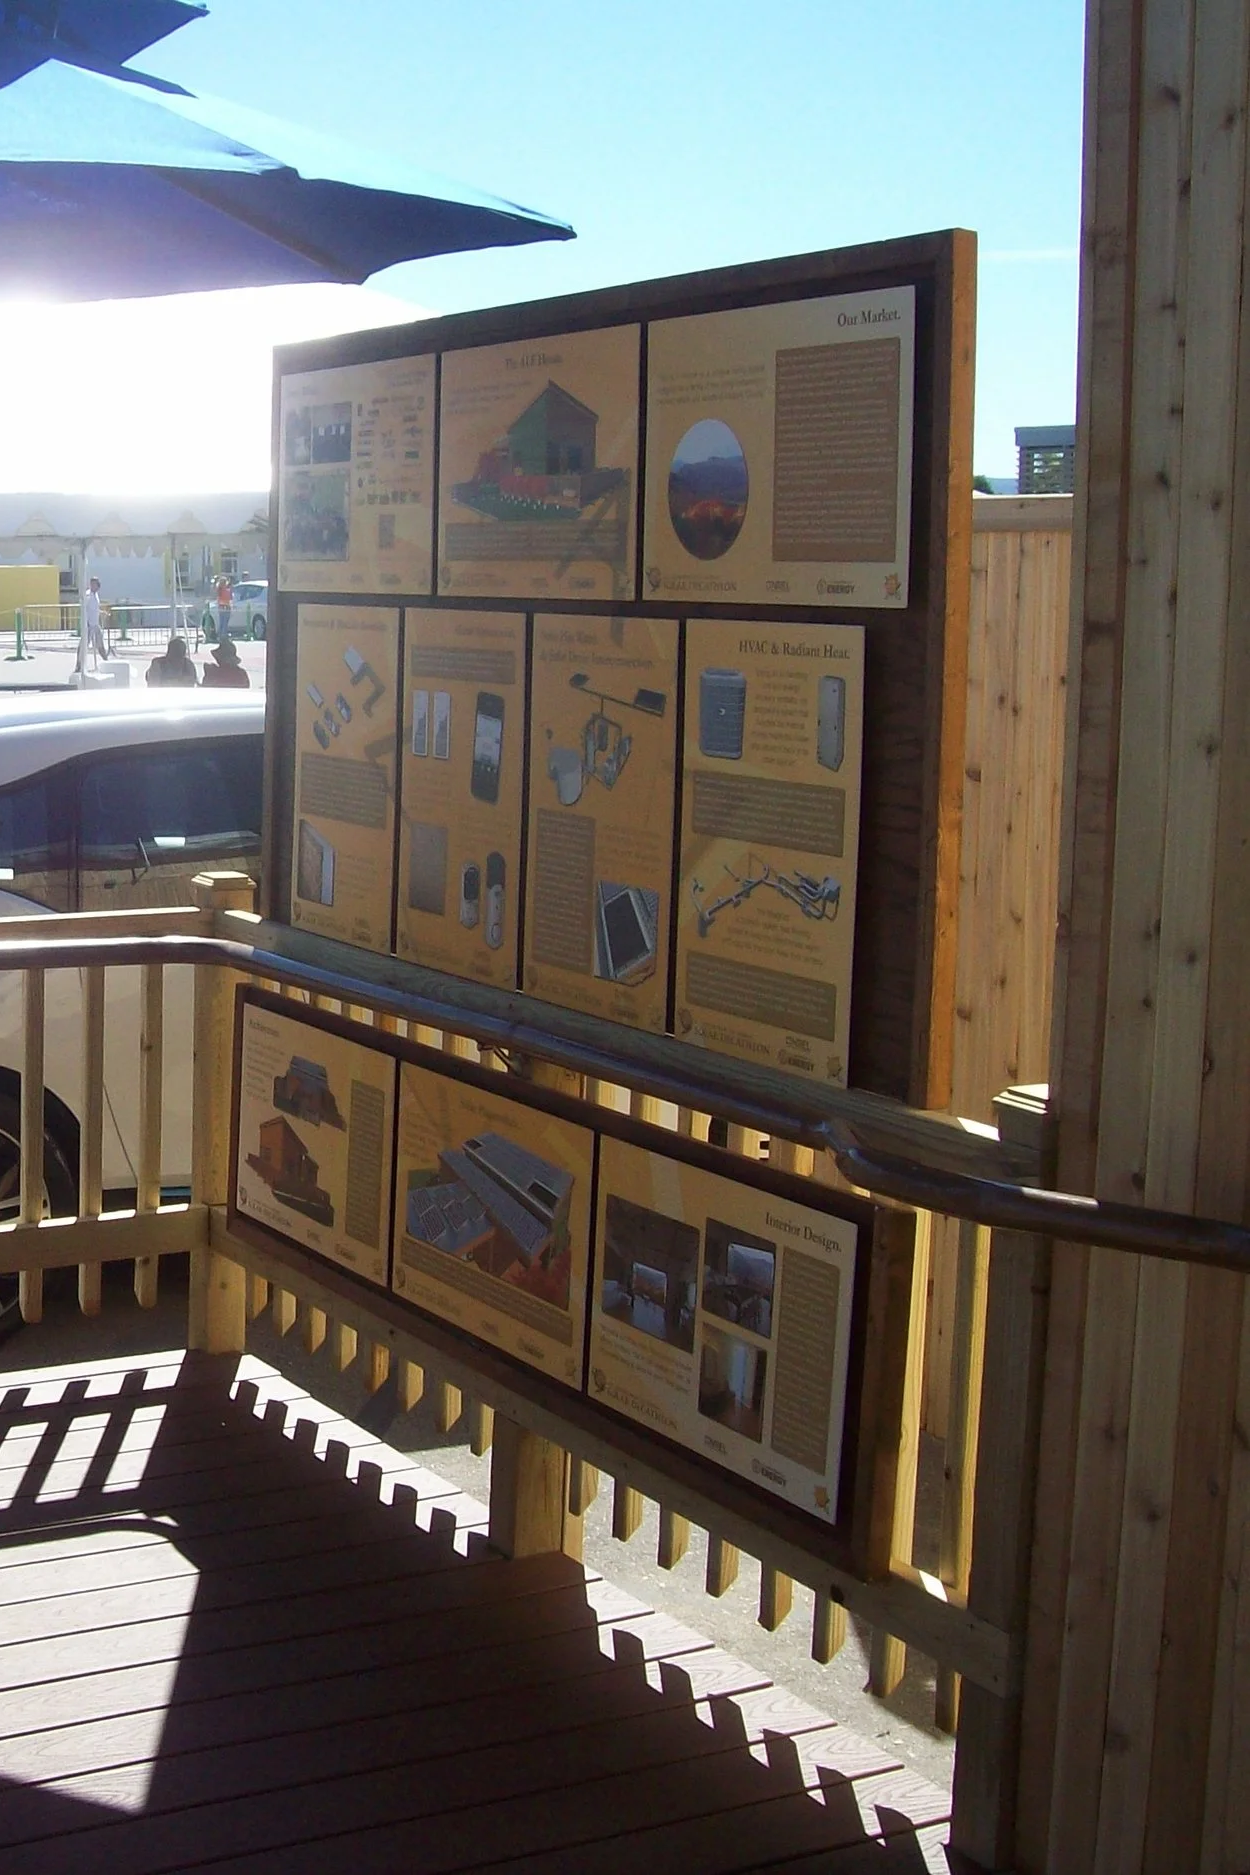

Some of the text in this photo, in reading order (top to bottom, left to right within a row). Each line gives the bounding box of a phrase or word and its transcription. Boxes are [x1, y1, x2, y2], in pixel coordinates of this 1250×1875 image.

[837, 307, 901, 328] Our Market.
[739, 640, 767, 654] HVAC
[771, 642, 780, 655] &
[783, 642, 820, 658] Radiant
[766, 1211, 842, 1253] Interior Design.
